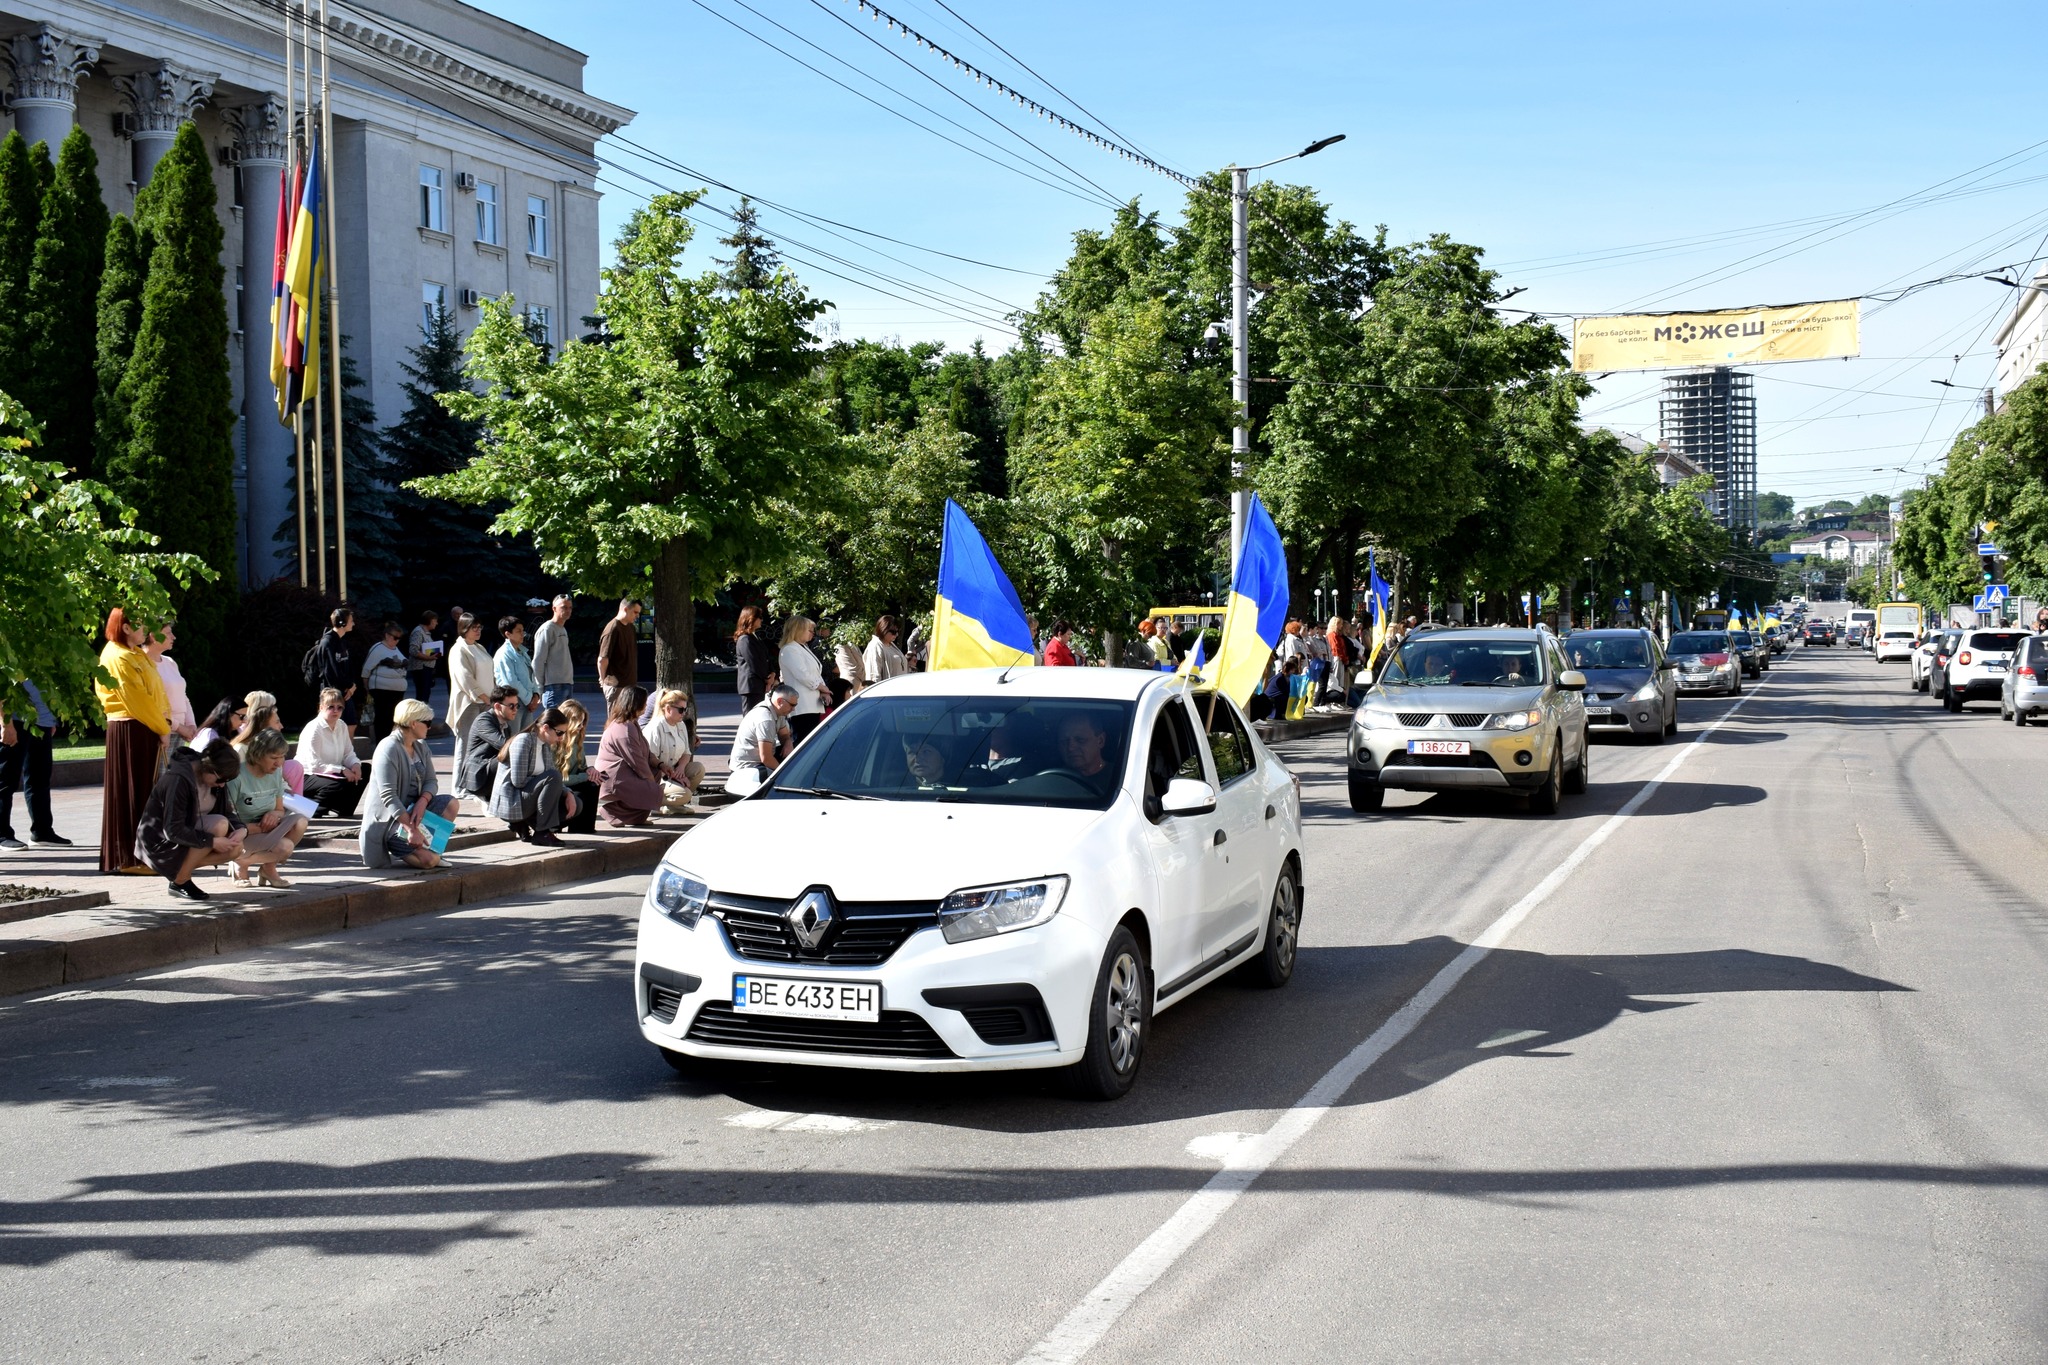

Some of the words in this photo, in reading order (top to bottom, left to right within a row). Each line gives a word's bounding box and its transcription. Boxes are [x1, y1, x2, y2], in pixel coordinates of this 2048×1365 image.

[1771, 318, 1810, 326] дістатися
[1811, 313, 1853, 324] будь-якої
[1804, 324, 1823, 332] місті
[1580, 331, 1594, 339] Рух
[1421, 742, 1462, 753] 1362CZ
[736, 996, 746, 1004] UA
[749, 981, 778, 1006] BE
[785, 984, 834, 1009] 6433
[840, 987, 872, 1012] EH
